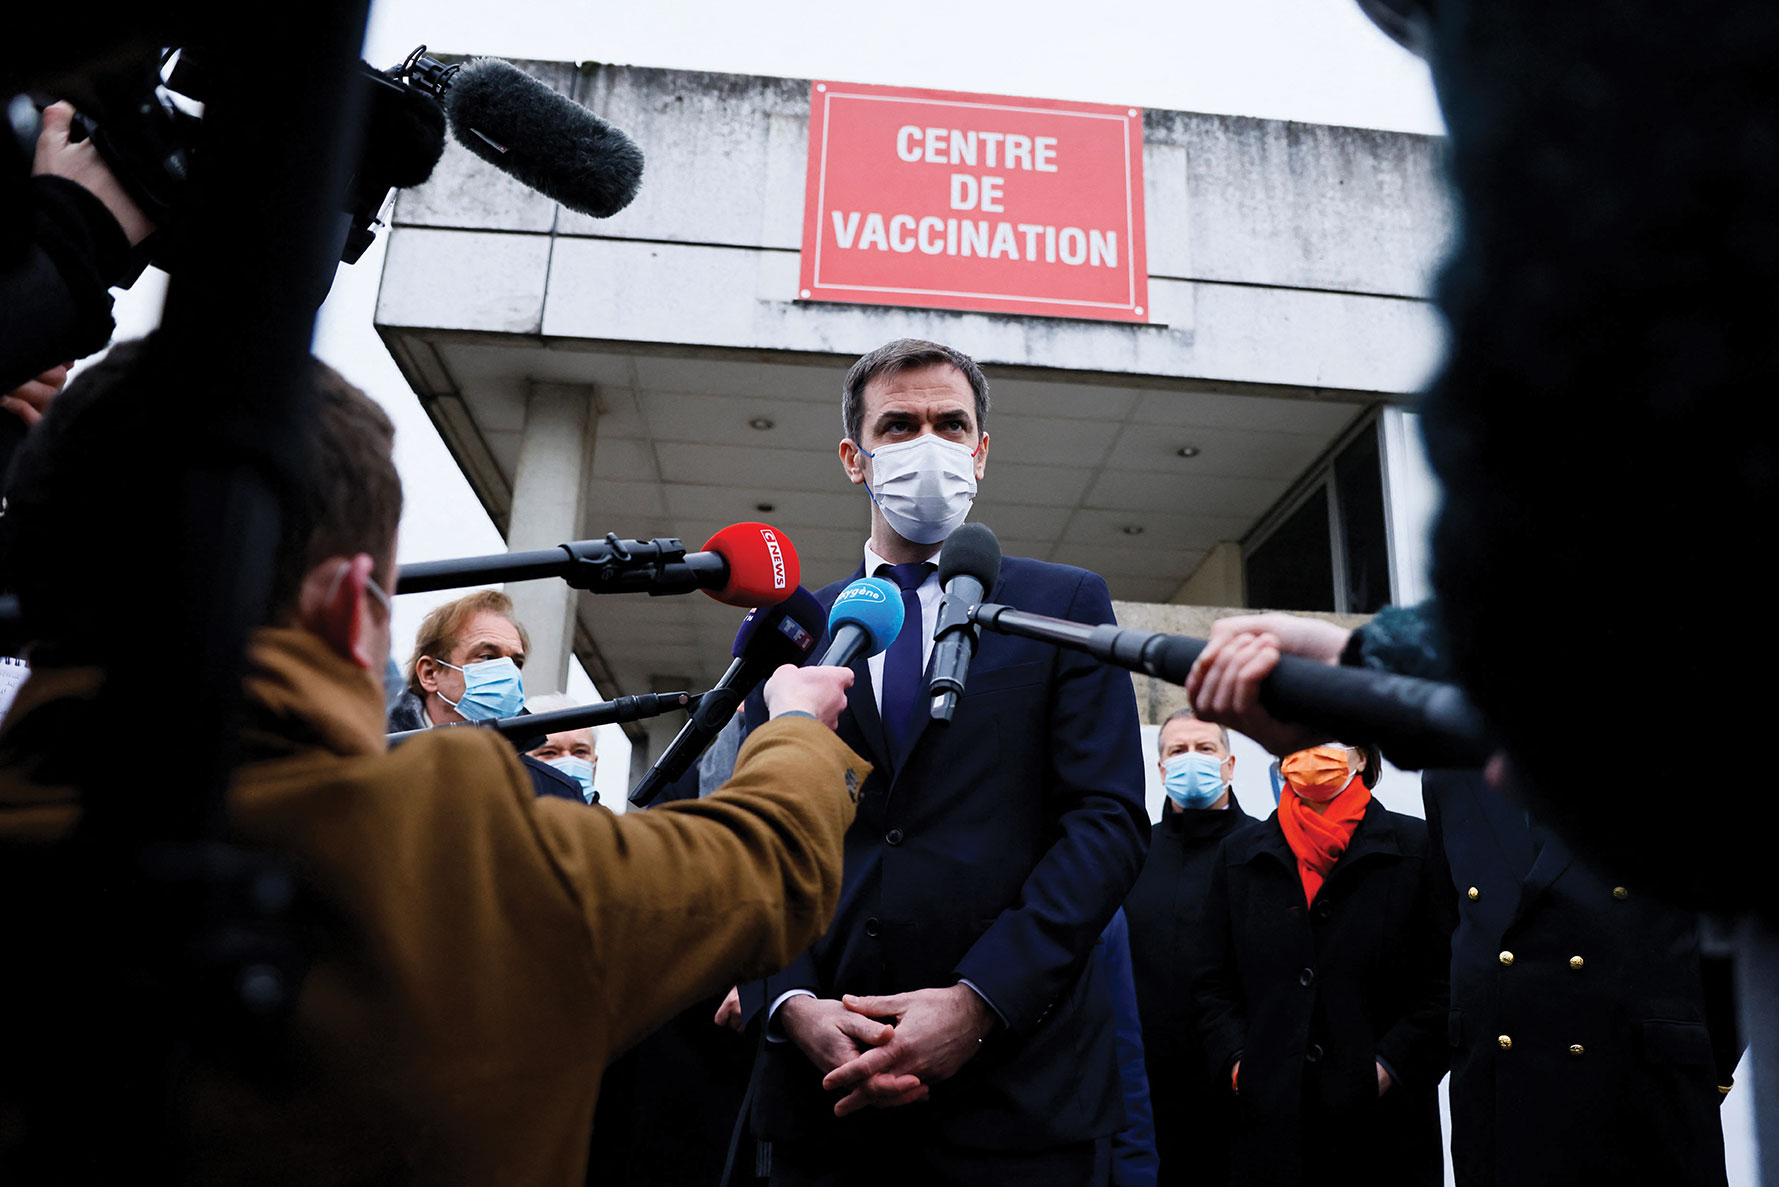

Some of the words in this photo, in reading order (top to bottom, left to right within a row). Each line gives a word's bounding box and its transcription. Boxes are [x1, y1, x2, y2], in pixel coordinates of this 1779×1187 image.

[896, 125, 1058, 172] CENTRE
[950, 173, 1005, 213] DE
[831, 210, 1118, 268] VACCINATION
